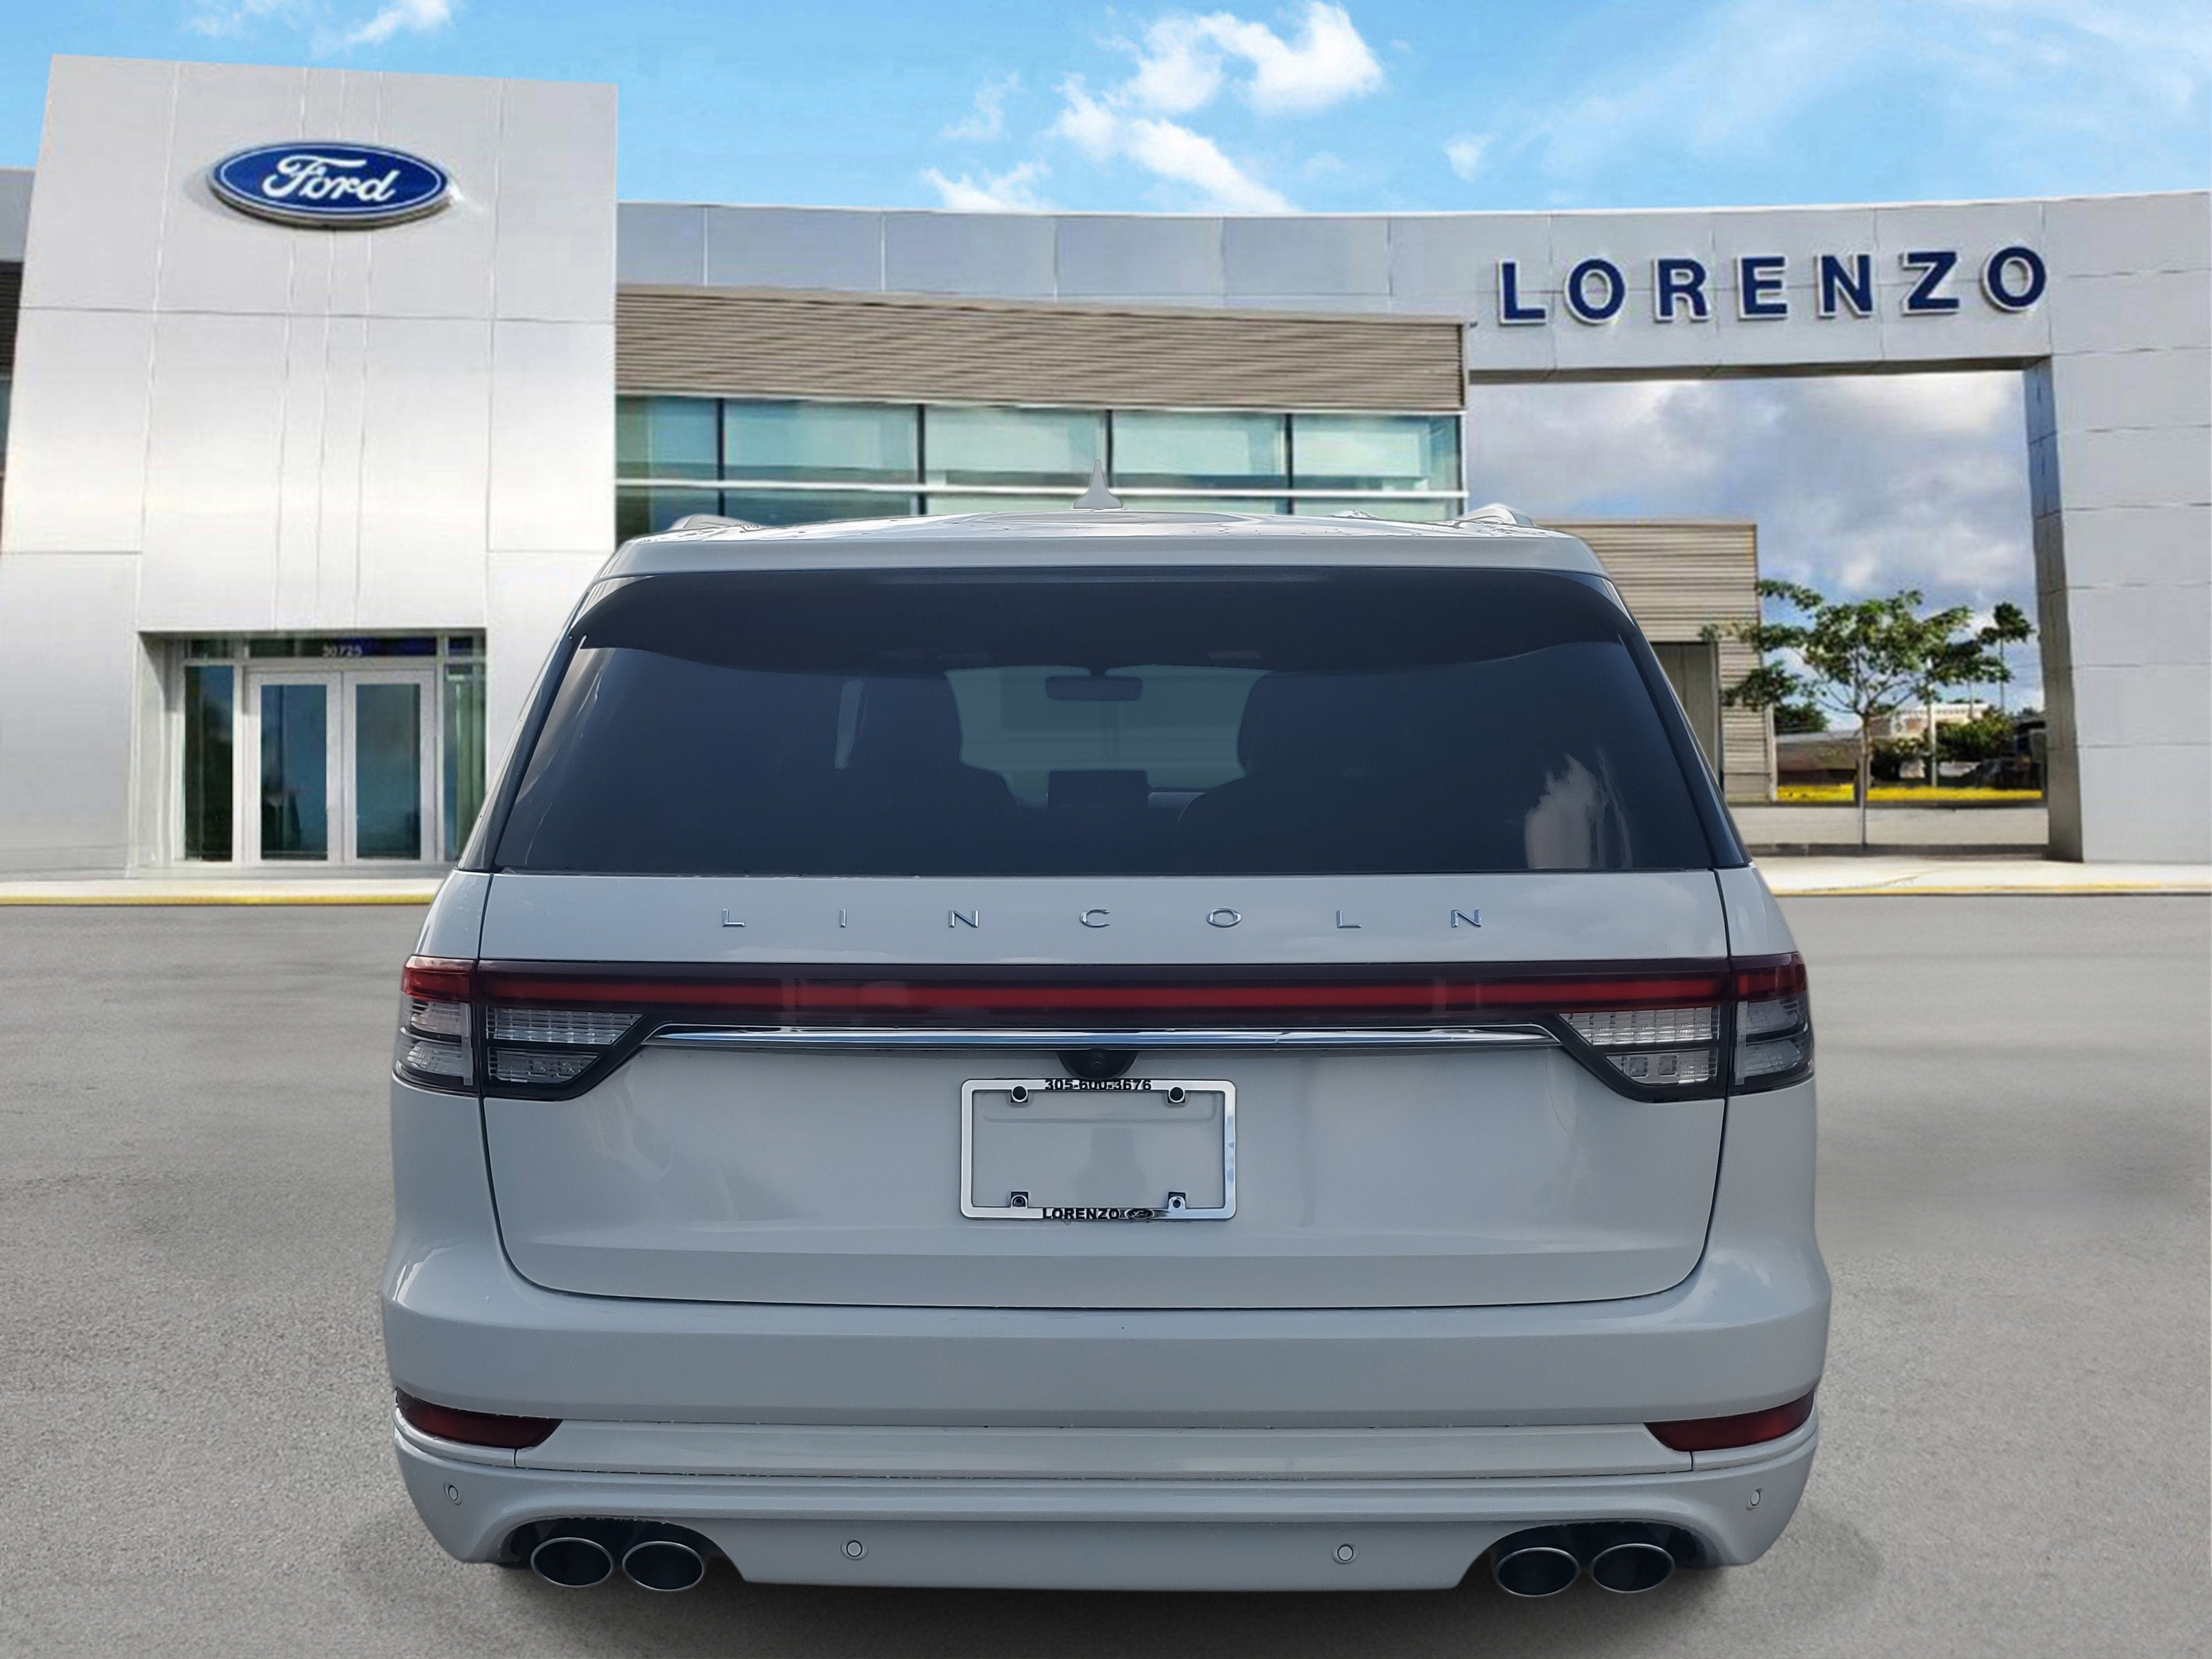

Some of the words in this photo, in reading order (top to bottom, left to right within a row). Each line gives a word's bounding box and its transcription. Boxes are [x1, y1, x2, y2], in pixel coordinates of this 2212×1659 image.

[262, 154, 401, 202] Ford
[1499, 246, 2047, 324] LORENZO
[721, 907, 1482, 929] LINCOLN
[1043, 1207, 1120, 1219] LORENZO
